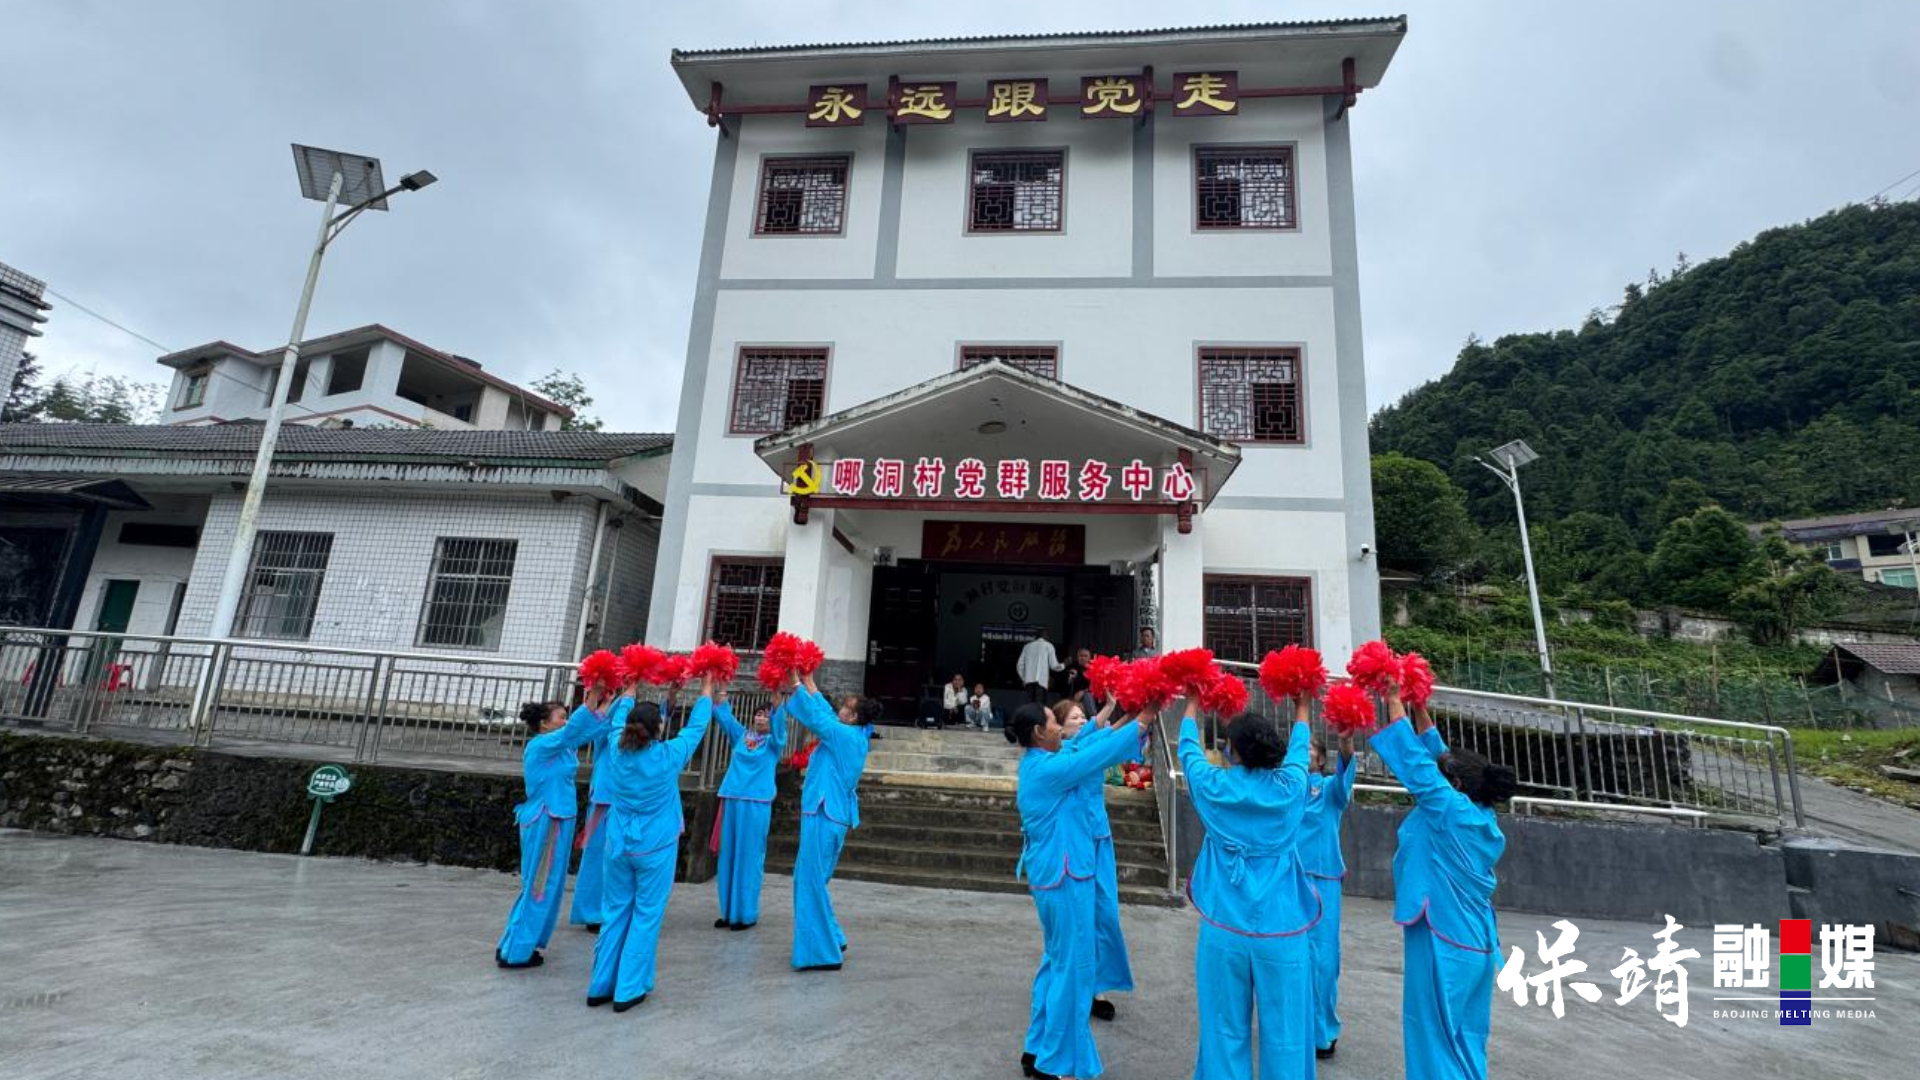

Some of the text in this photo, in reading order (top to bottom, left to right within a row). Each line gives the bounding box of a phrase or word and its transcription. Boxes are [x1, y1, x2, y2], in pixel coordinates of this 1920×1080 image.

[808, 72, 1237, 121] 永远跟党走
[832, 457, 1196, 501] 哪洞村党群服务中心
